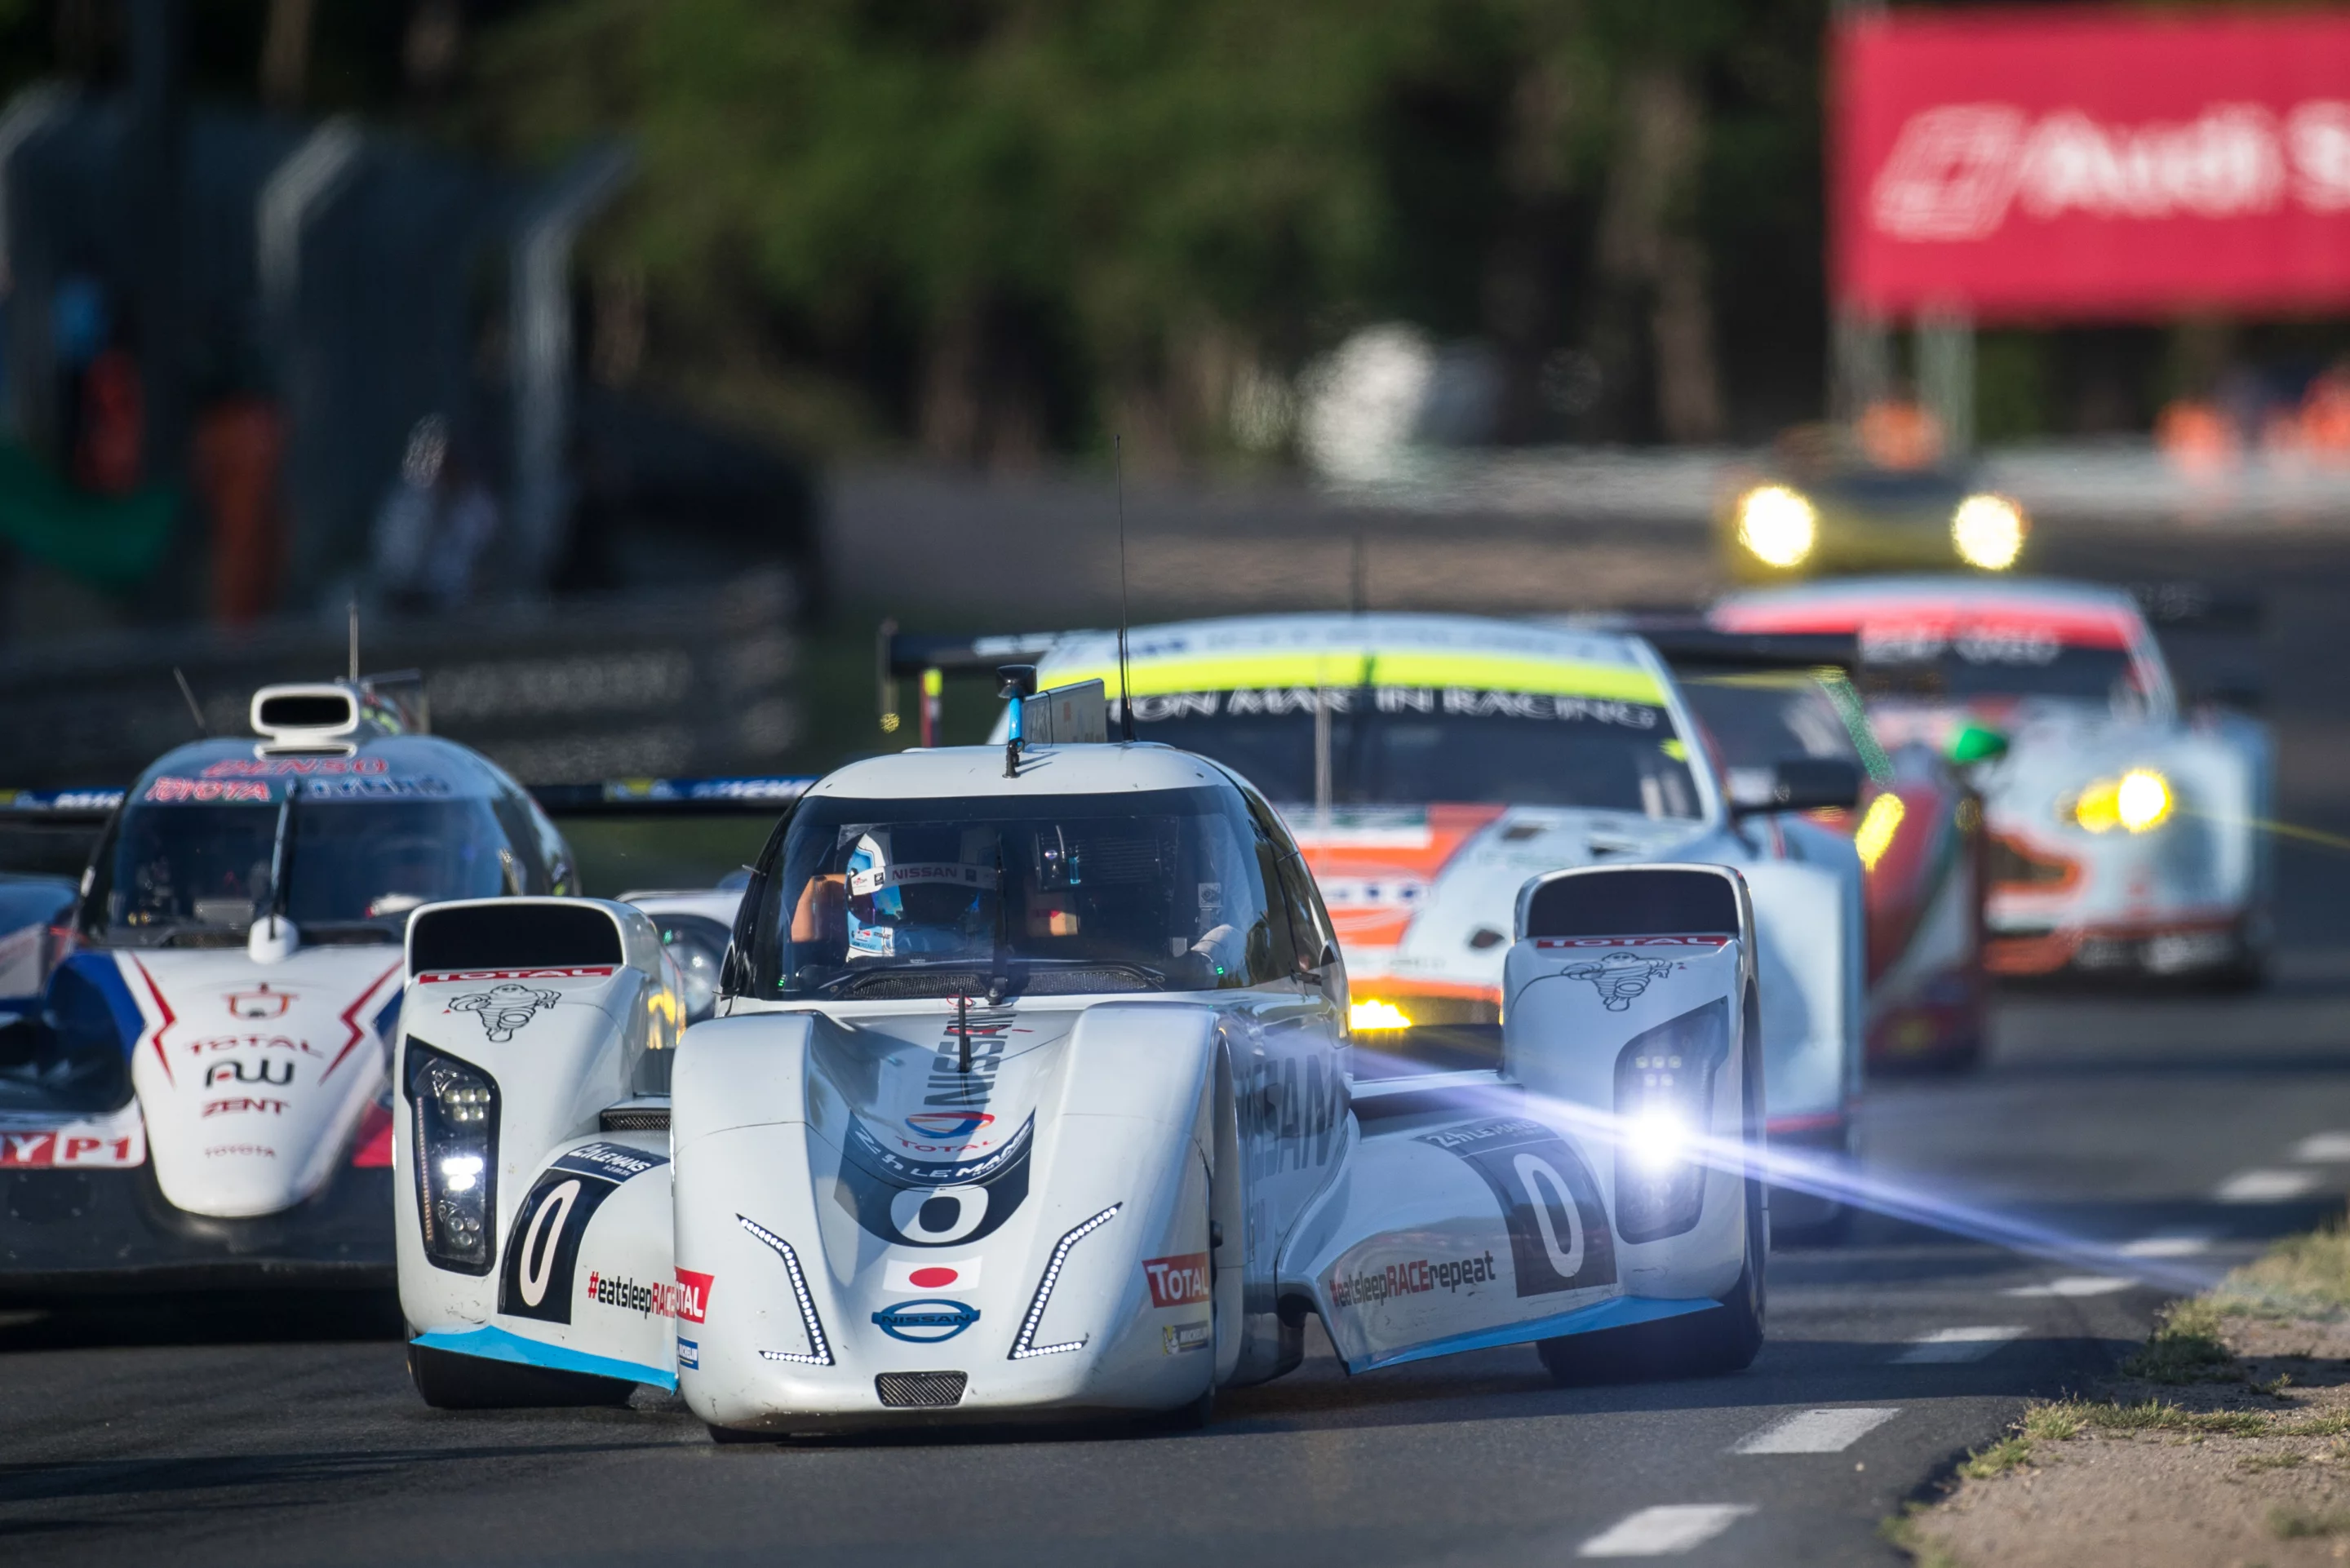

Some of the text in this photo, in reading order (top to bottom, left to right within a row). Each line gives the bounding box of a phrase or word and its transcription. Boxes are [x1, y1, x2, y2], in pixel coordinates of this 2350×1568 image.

[891, 867, 958, 881] NISSAN
[1543, 937, 1718, 947] TOTAL
[425, 968, 602, 981] TOTAL
[184, 1034, 324, 1060] TOTAL
[202, 1097, 291, 1119] ZENT
[64, 1136, 131, 1162] P1
[895, 1136, 999, 1153] TOTAL
[910, 1168, 952, 1178] LE
[890, 1185, 989, 1243] 0
[1513, 1153, 1585, 1278] 0
[520, 1180, 581, 1307] 0
[881, 1313, 970, 1323] NISSAN
